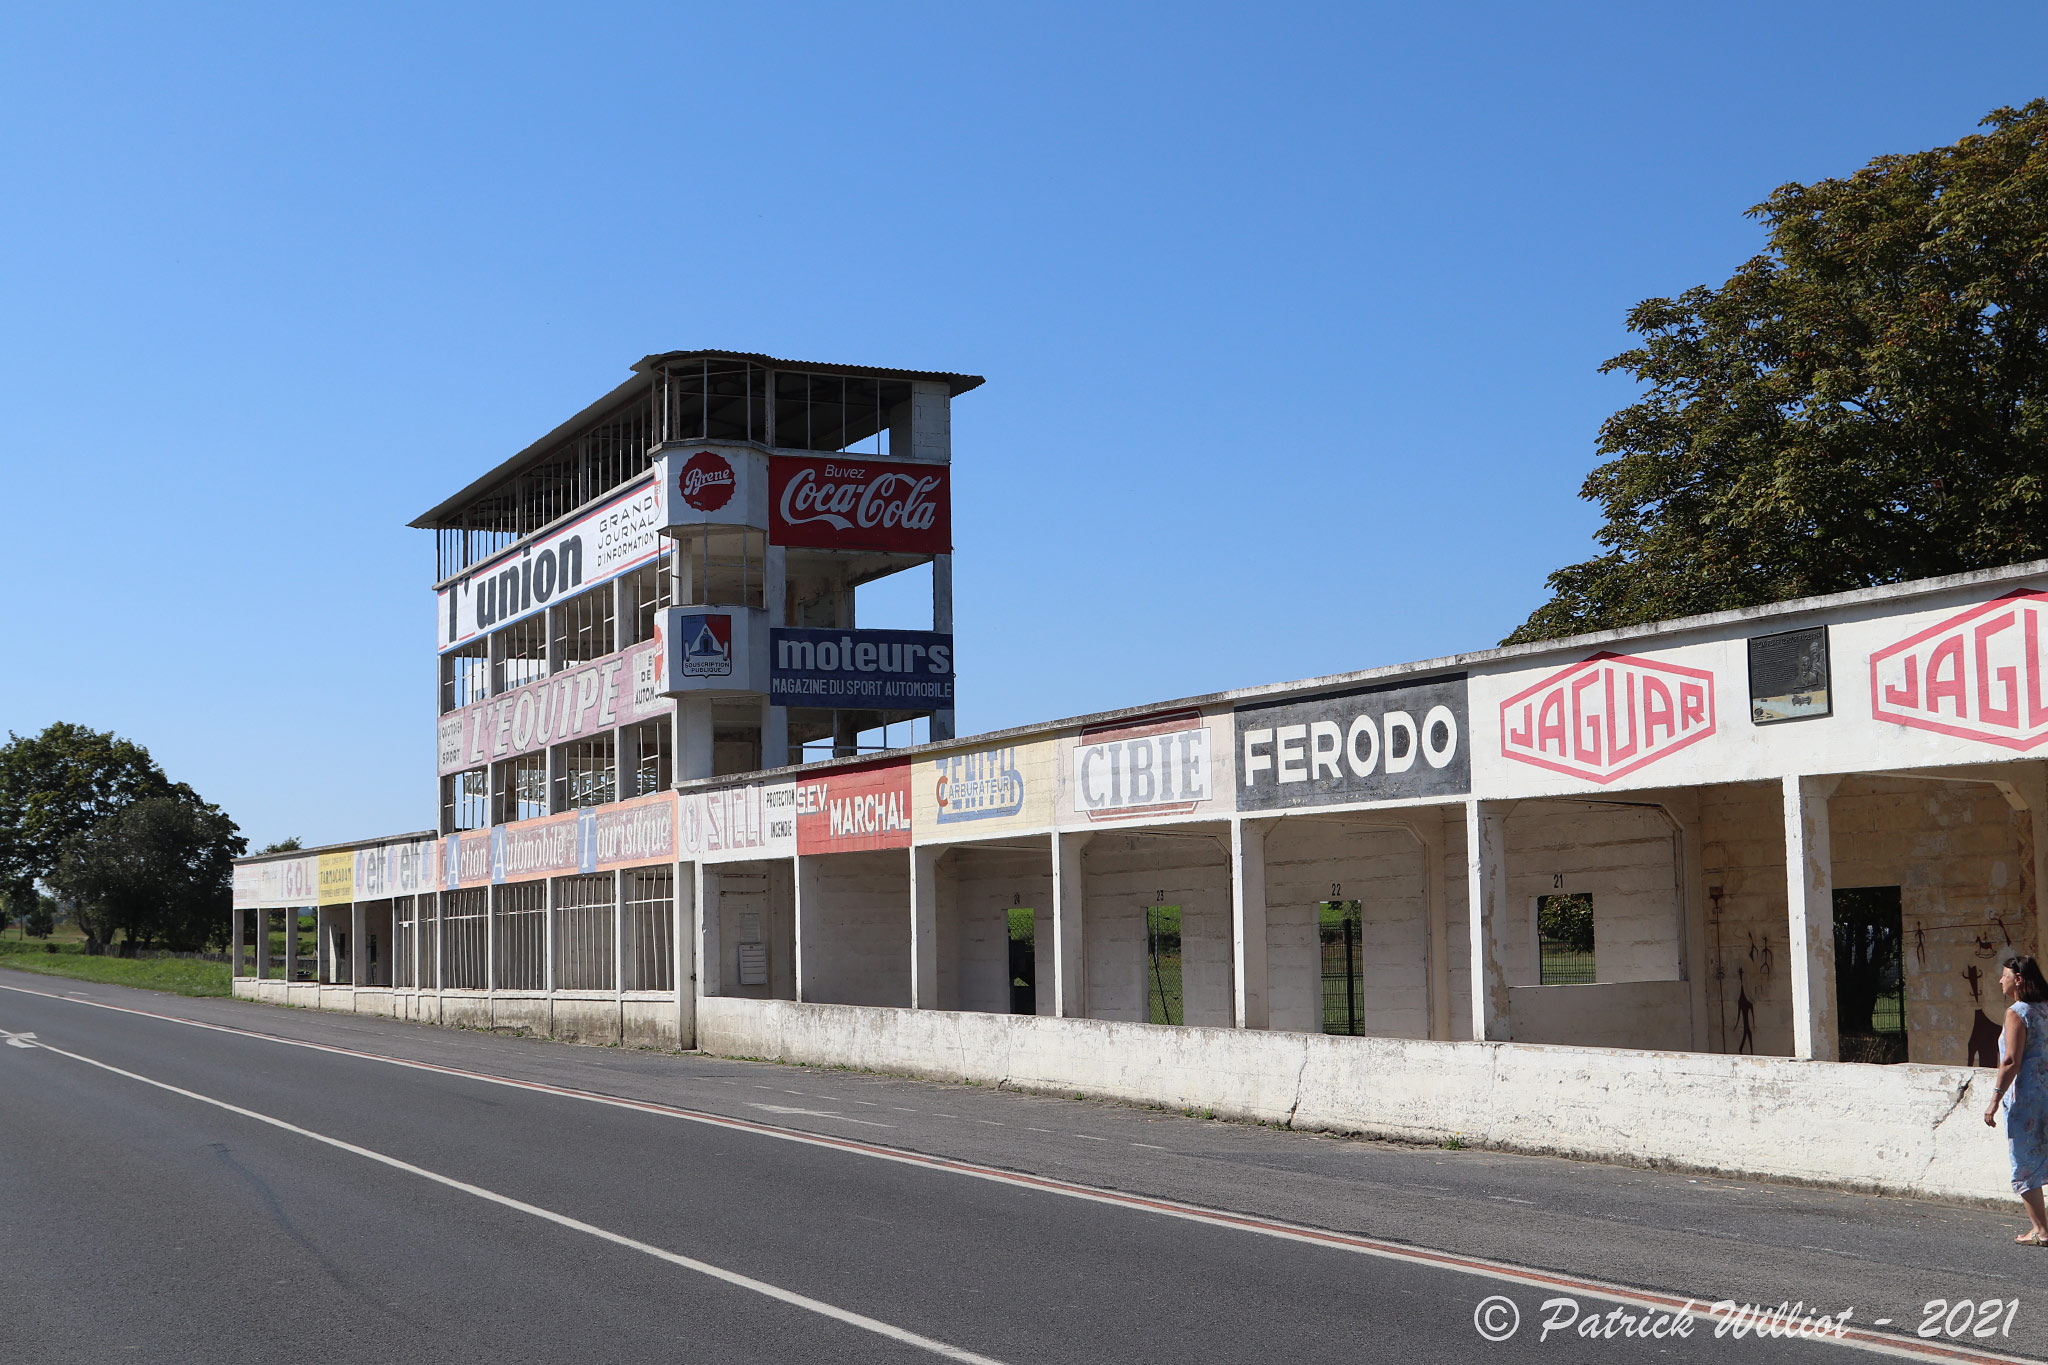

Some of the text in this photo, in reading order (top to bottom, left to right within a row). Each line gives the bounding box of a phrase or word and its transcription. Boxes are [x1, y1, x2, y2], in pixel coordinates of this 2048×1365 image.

[683, 468, 730, 496] Pyrene
[824, 464, 866, 480] Buvez
[600, 496, 653, 533] GRAND
[779, 468, 942, 531] Coca-Cola
[598, 515, 655, 551] JOURNAL
[598, 534, 655, 567] D'INFORMATION
[778, 636, 951, 674] moteurs
[641, 670, 652, 682] DE
[772, 679, 952, 698] MAGAZINE DU SPORT AUTOMOBILE
[469, 657, 622, 763] L'EQUIPE
[635, 686, 662, 706] AUTOM
[1510, 668, 1706, 768] JAGUAR
[442, 749, 460, 765] SPORT
[1245, 705, 1458, 787] FERODO
[766, 789, 795, 808] PROTECTION
[936, 776, 1010, 808] CARBURATEUR
[830, 790, 911, 837] MARCHAL
[491, 825, 564, 880] Automobile
[580, 810, 669, 868] Touristique
[280, 860, 313, 898] IGOL
[367, 843, 386, 896] elf
[400, 839, 421, 892] elf
[1553, 873, 1565, 890] 21
[1156, 889, 1165, 902] 23
[1331, 883, 1342, 897] 22
